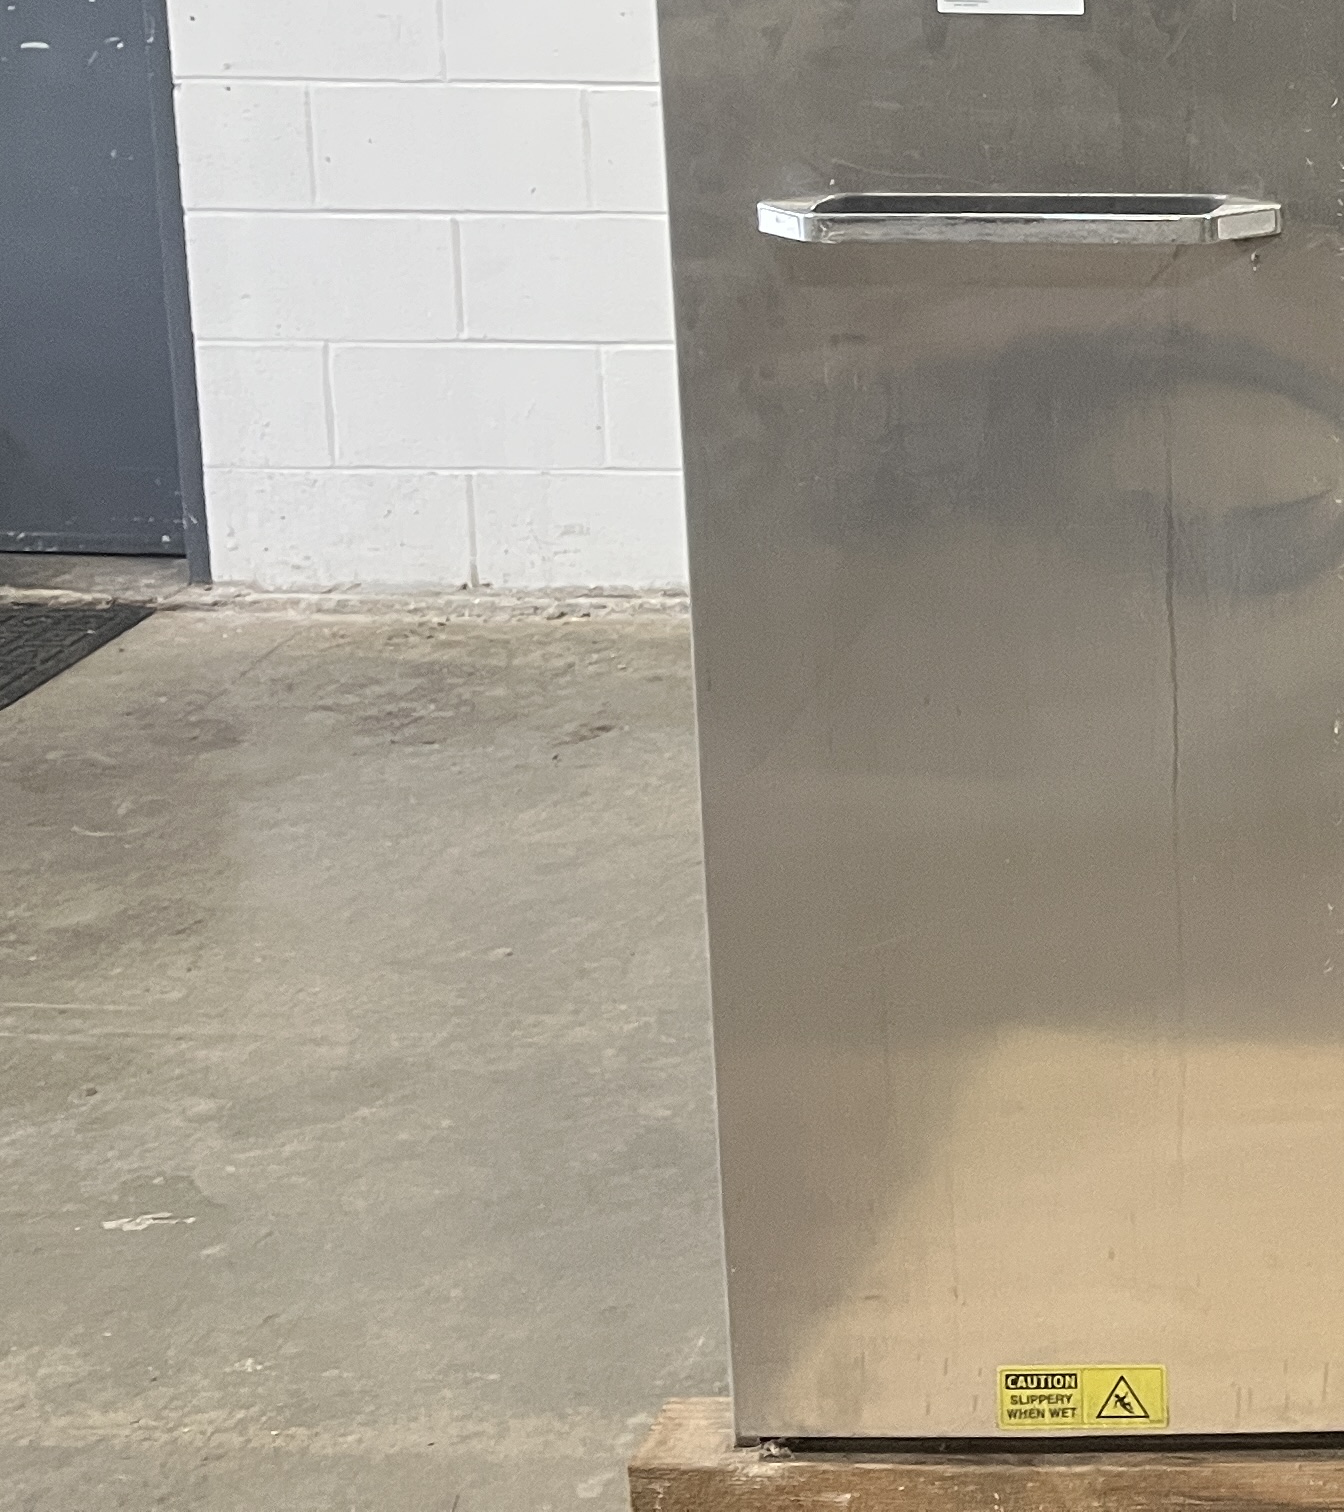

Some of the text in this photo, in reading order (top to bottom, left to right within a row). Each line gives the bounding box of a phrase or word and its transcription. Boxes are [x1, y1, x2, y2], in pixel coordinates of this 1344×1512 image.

[1007, 1374, 1076, 1389] CAUTION
[1010, 1393, 1073, 1406] SLIPPERY
[1006, 1407, 1076, 1420] WHEN WET
